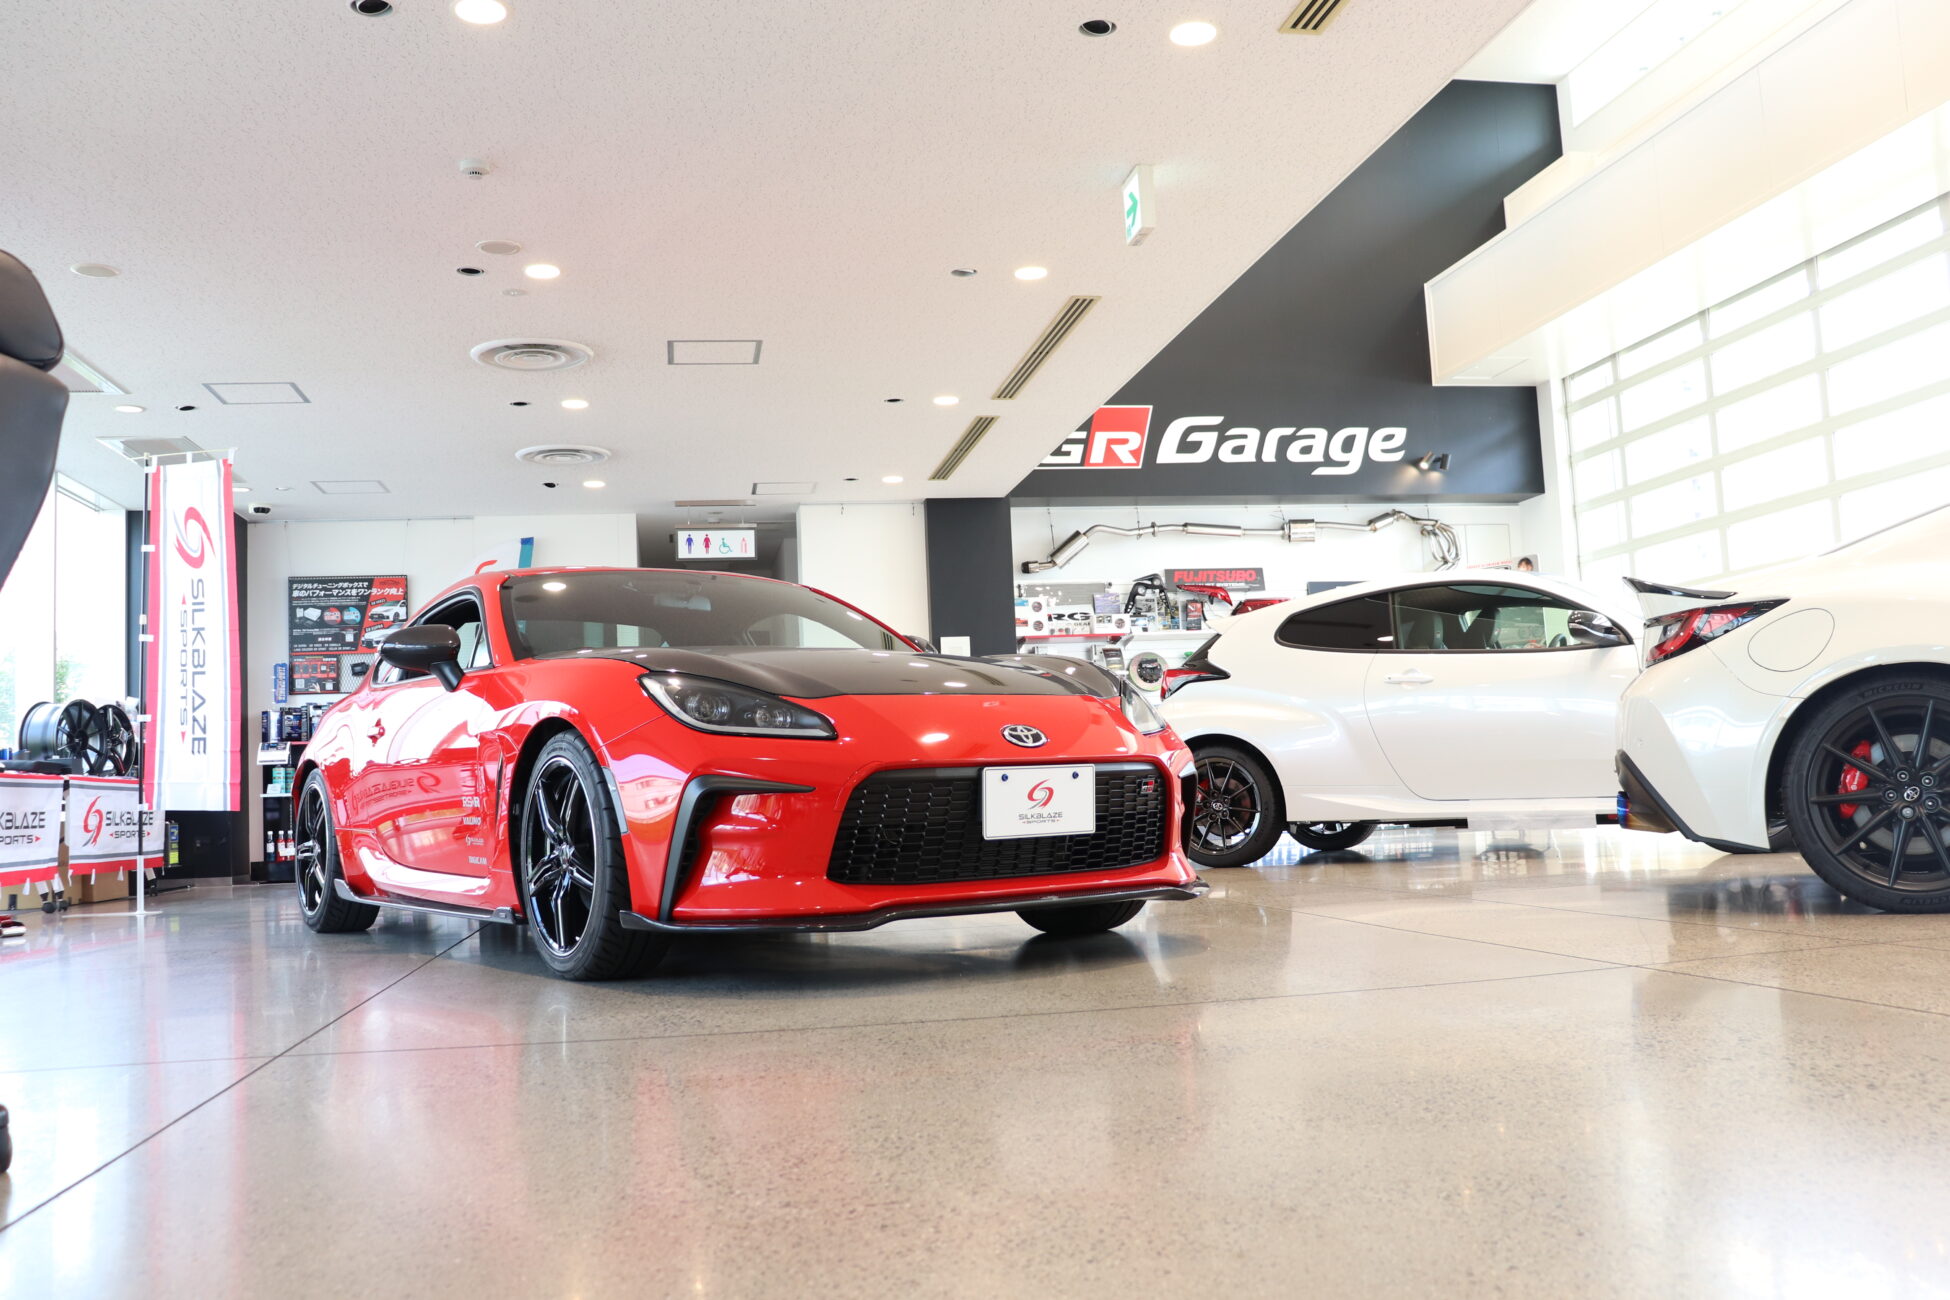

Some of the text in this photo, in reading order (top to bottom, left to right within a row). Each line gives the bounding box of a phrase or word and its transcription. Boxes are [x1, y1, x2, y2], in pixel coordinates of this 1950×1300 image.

[1042, 416, 1407, 475] GR Garage
[1173, 570, 1257, 583] FUJITSUBO
[180, 609, 188, 727] SPORTS
[191, 577, 207, 755] SILKBLAZE
[105, 811, 153, 827] SILKBLZE
[1018, 811, 1063, 820] SILKBLAZE
